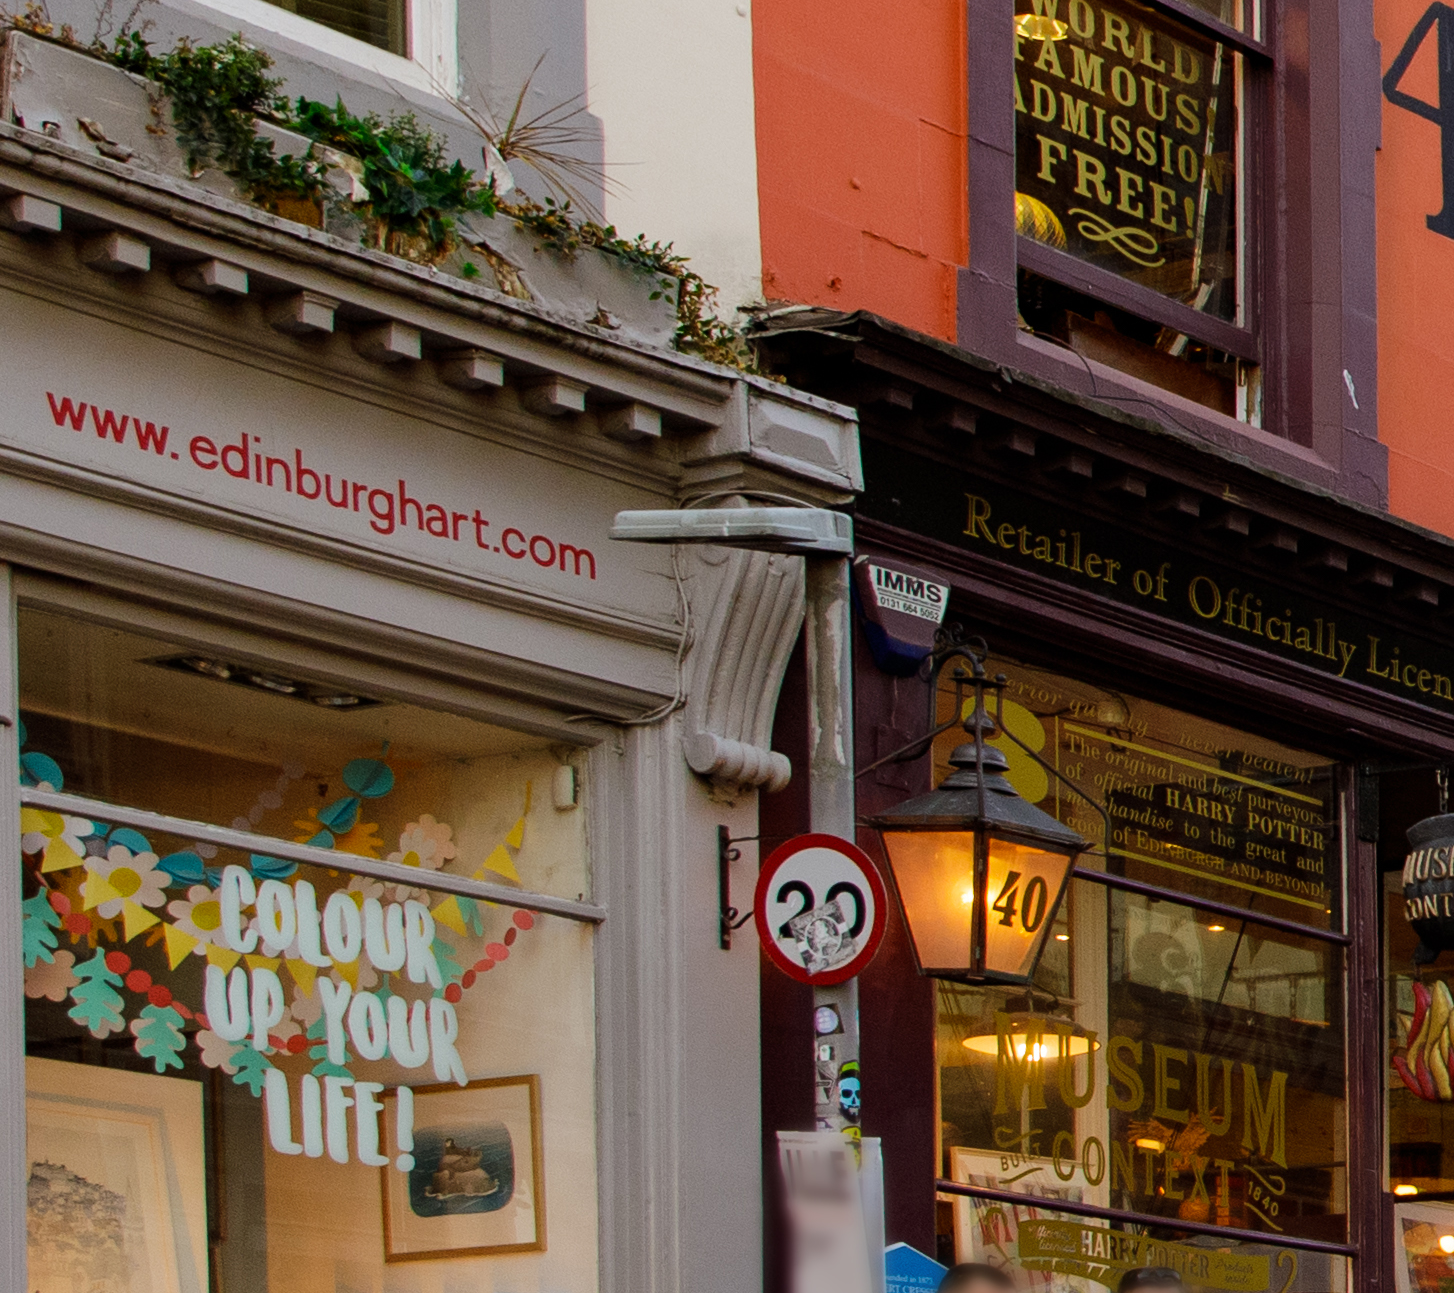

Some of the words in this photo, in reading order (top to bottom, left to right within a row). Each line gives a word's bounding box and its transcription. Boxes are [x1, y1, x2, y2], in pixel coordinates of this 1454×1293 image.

[1015, 30, 1200, 136] FAMOUS
[1036, 134, 1195, 239] FREE!
[877, 568, 942, 604] IMMS
[880, 597, 901, 611] 0131
[964, 494, 1120, 586] Retailer
[1133, 562, 1172, 602] of
[1189, 575, 1356, 680] Officially
[1065, 733, 1101, 758] The
[1105, 751, 1174, 782] original
[1178, 768, 1208, 793] and
[1212, 776, 1243, 804] best
[1248, 792, 1325, 829] purveyors
[1243, 748, 1315, 784] beaten!
[1065, 763, 1083, 781] of
[1094, 772, 1155, 802] official
[1166, 787, 1236, 825] HARRY
[1247, 812, 1325, 850] POTTER
[1114, 827, 1132, 844] of
[1231, 861, 1262, 880] AND
[1184, 820, 1200, 839] to
[1210, 828, 1236, 850] the
[1246, 841, 1288, 866] great
[1296, 856, 1325, 876] and
[219, 865, 442, 989] COLOUR
[776, 880, 867, 941] 20
[992, 870, 1048, 934] 40
[204, 965, 285, 1052] UP
[318, 978, 468, 1085] YOUR
[993, 1012, 1289, 1169] MUSEUM
[1053, 1130, 1236, 1208] CONTEXT
[1247, 1180, 1280, 1216] 1840
[1081, 1229, 1141, 1264] HARRY
